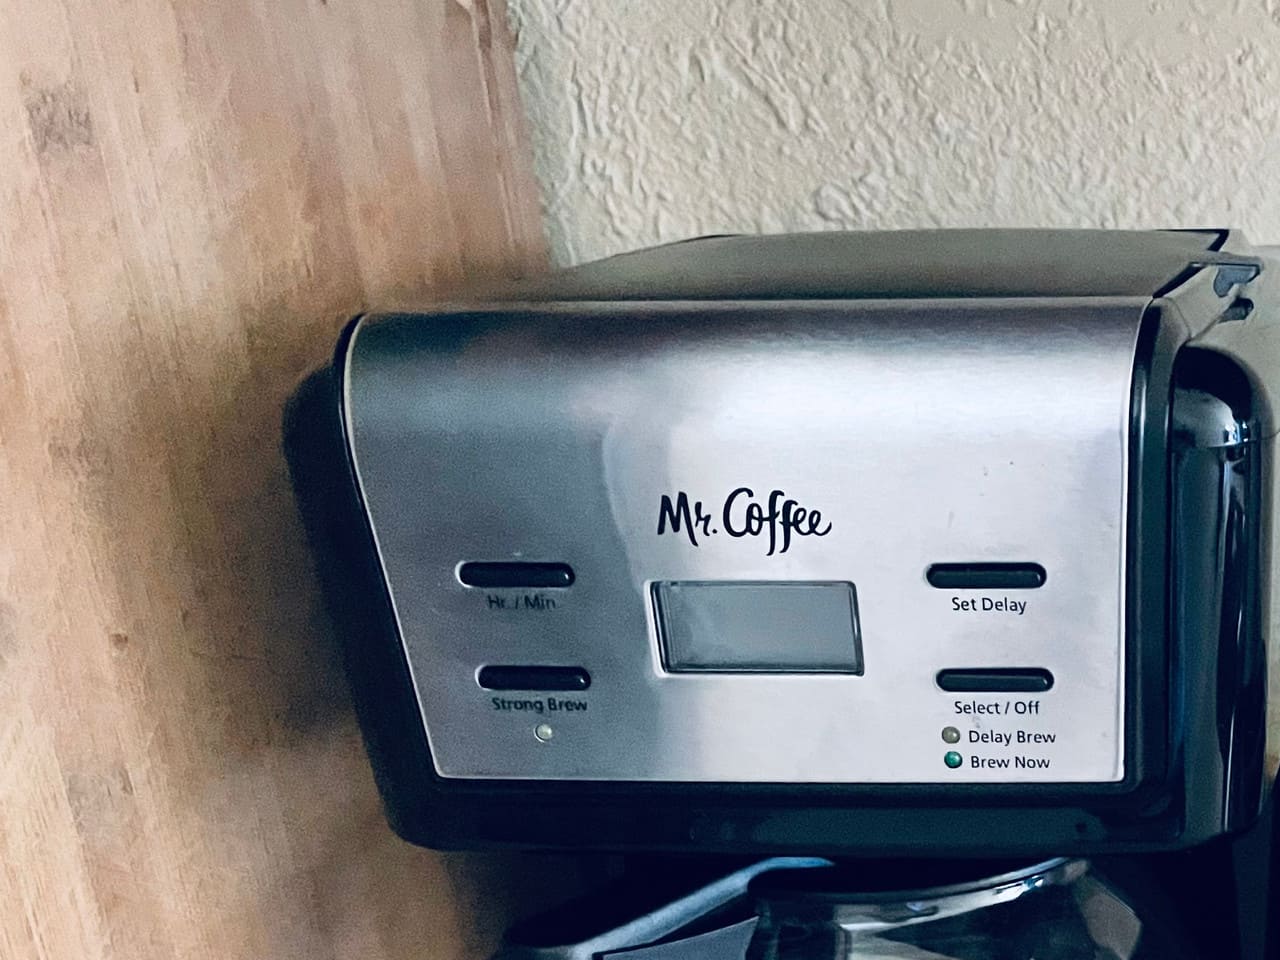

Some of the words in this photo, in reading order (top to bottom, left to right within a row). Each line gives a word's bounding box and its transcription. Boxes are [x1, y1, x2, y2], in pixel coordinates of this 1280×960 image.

[657, 491, 718, 547] Mr.
[723, 487, 832, 556] Coffee
[525, 594, 556, 610] Min
[952, 597, 977, 611] Set
[982, 597, 1027, 615] Delay
[492, 697, 544, 713] Strong
[548, 698, 588, 712] Brew
[954, 700, 1000, 715] Select
[1014, 701, 1040, 715] Off
[969, 730, 1012, 746] Delay
[1017, 731, 1056, 743] Brew
[971, 756, 1010, 769] Brew
[1015, 756, 1050, 768] Now
